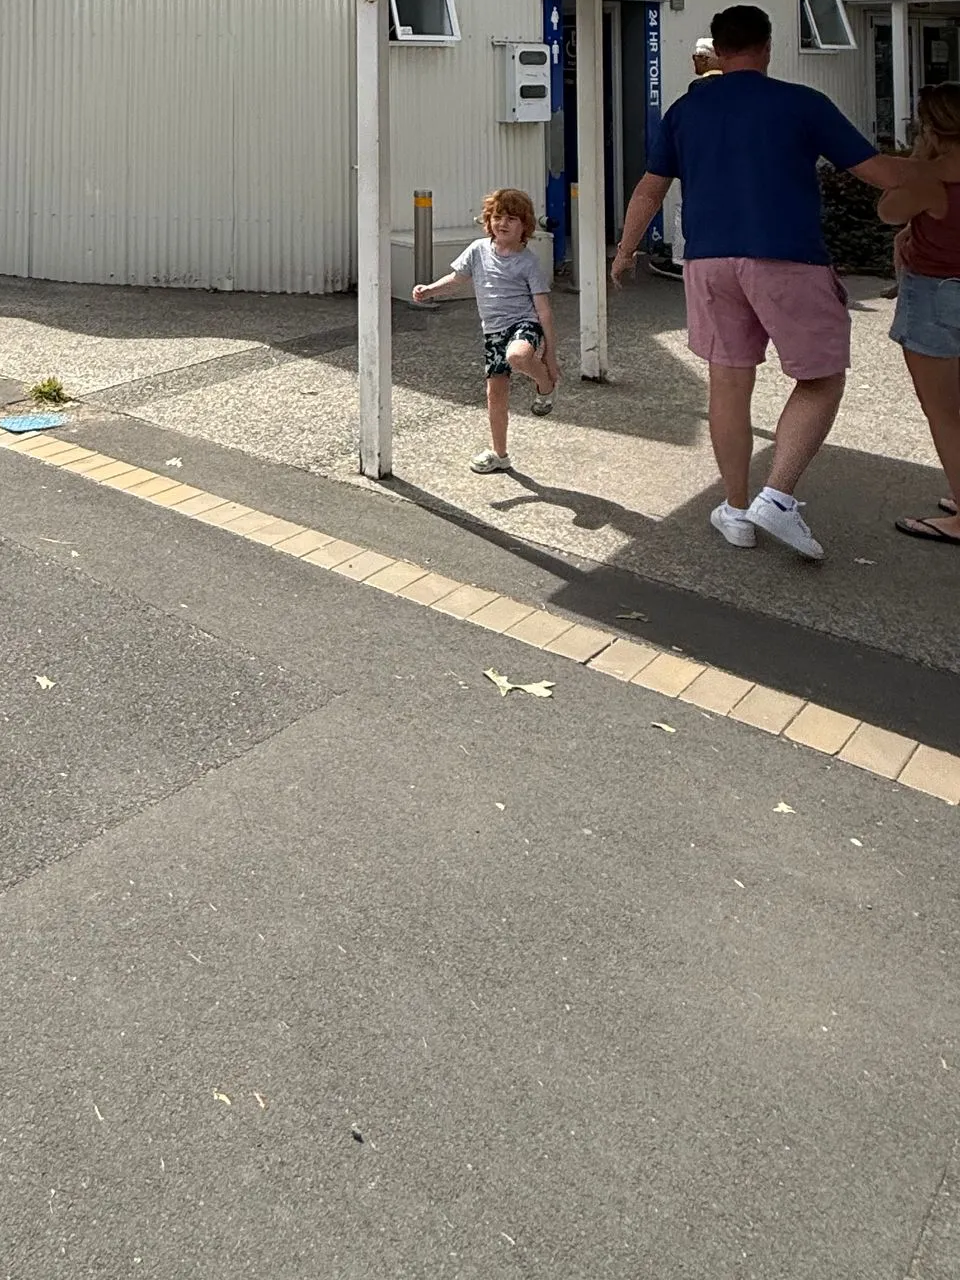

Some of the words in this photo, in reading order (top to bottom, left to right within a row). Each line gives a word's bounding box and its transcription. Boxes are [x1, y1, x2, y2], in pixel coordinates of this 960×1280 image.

[648, 9, 658, 26] 24
[649, 31, 658, 52] HR
[649, 58, 659, 106] TOILET
